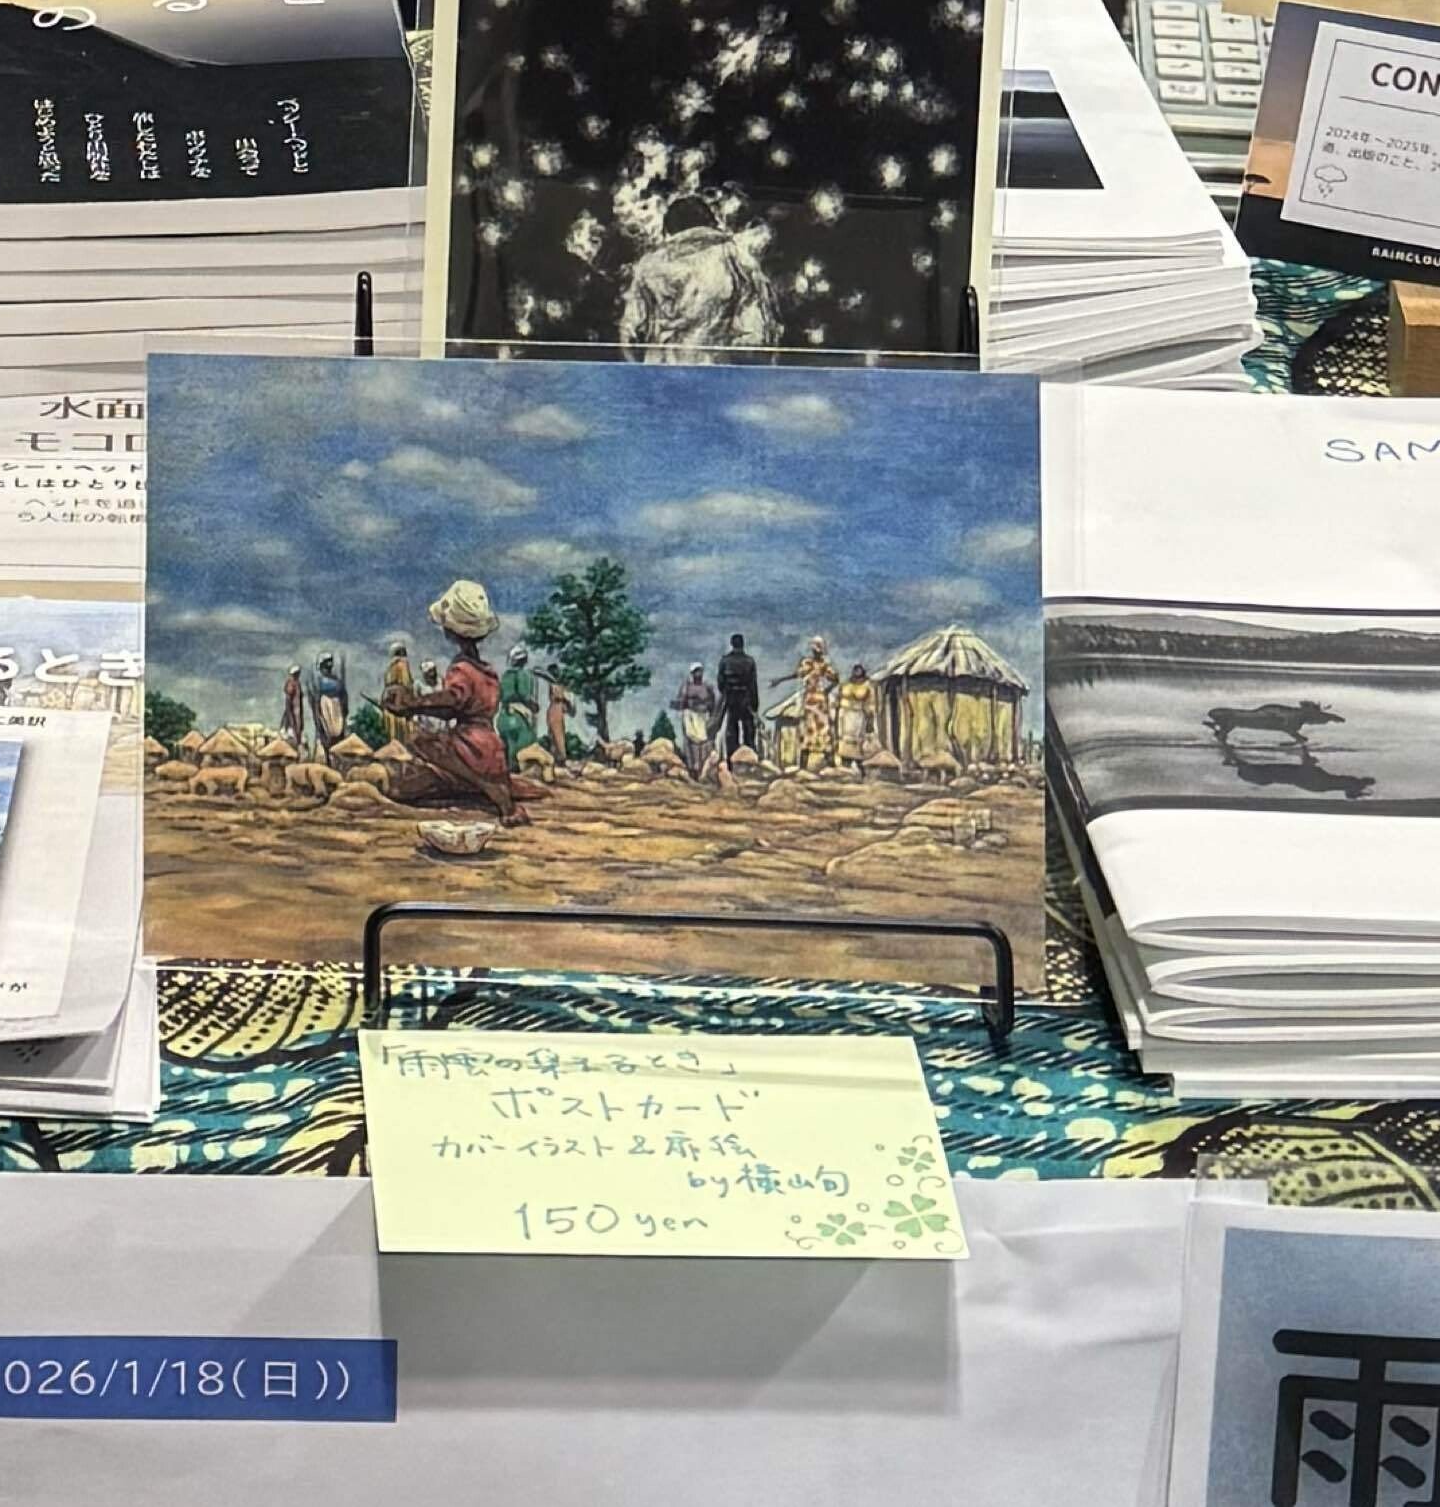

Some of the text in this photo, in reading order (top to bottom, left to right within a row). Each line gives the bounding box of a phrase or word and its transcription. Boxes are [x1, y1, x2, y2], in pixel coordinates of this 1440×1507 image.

[381, 1043, 738, 1080] 「雨雲の集まるとき」
[491, 1085, 760, 1123] ポストカード
[688, 1169, 730, 1200] by
[516, 1203, 708, 1242] 150 yen
